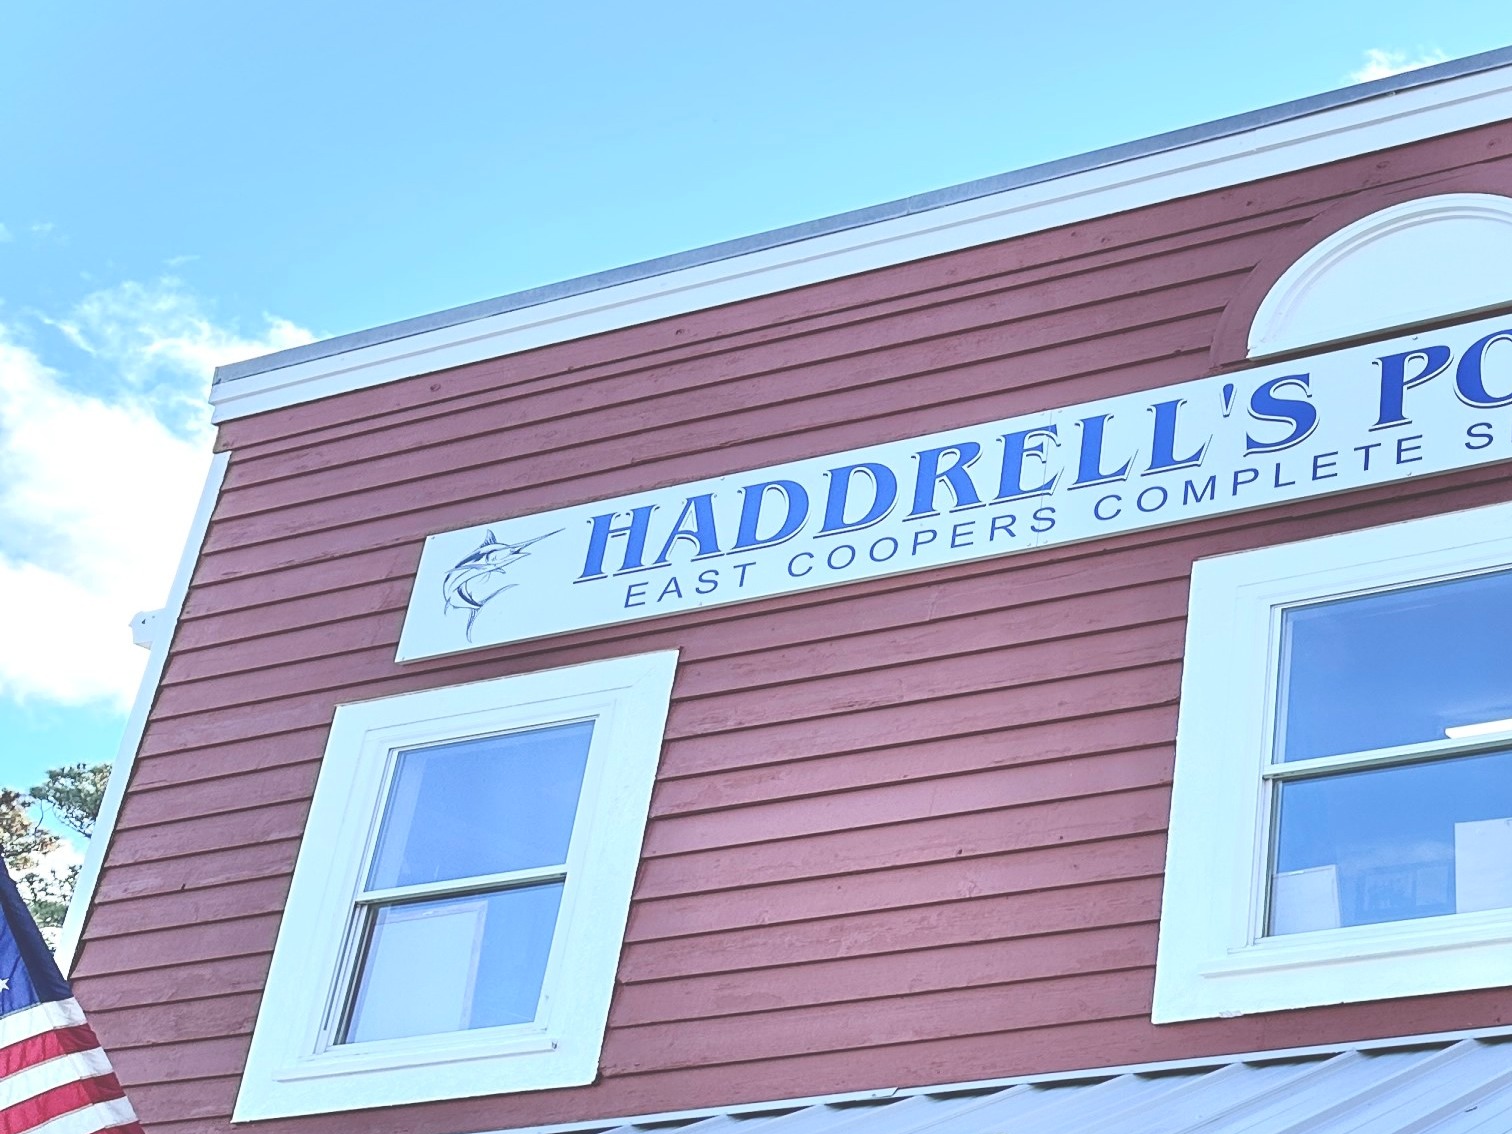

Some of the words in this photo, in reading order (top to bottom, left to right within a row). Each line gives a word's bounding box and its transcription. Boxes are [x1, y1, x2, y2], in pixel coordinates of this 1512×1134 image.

[573, 372, 1320, 584] HADDRELL'S
[623, 561, 757, 609] EAST
[786, 505, 1058, 579] COOPERS
[1092, 434, 1425, 522] COMPLETE
